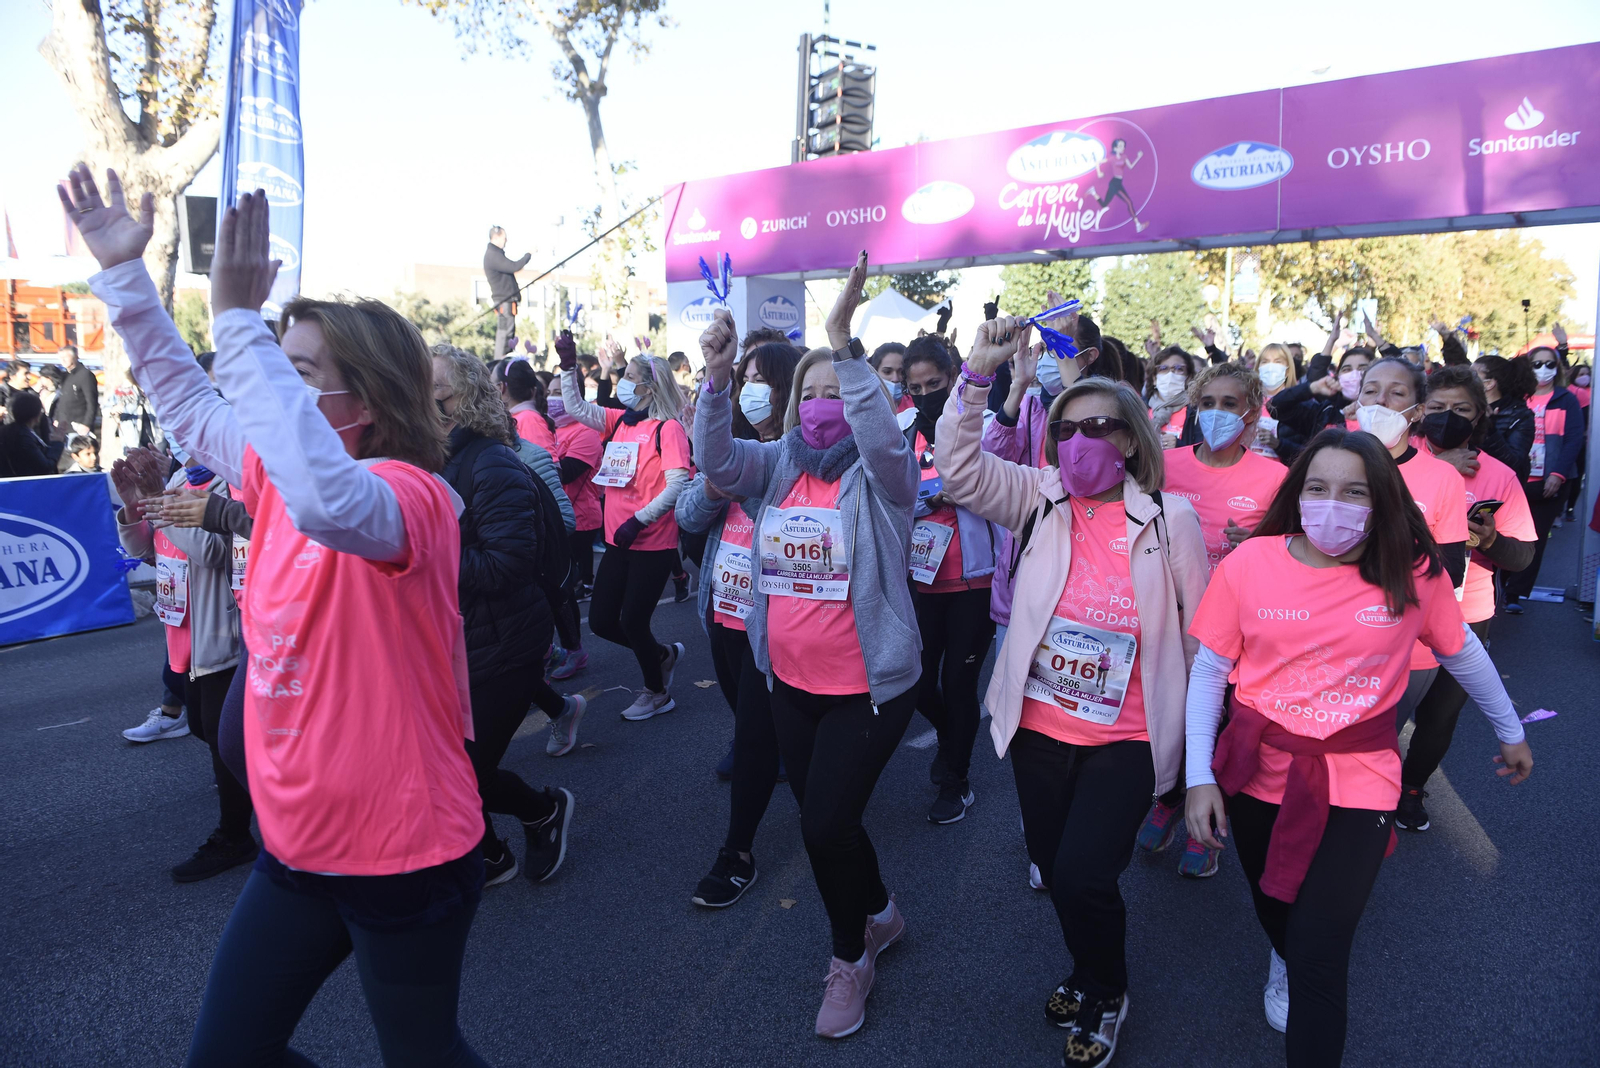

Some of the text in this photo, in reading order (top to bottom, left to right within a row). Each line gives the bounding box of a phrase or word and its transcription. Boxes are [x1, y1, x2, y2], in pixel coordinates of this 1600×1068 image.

[1468, 130, 1581, 157] Santander
[1326, 138, 1431, 169] OYSHO
[1200, 160, 1285, 180] ASTURIANA
[998, 182, 1080, 210] Carrera
[826, 204, 887, 227] OYSHO
[1017, 198, 1110, 243] de la Mujer
[761, 216, 807, 233] ZURICH
[673, 230, 721, 246] Santander
[762, 307, 797, 321] ASTURIANA
[611, 459, 626, 468] 016
[1229, 499, 1256, 509] ASTURIANA
[784, 523, 821, 534] ASTURIANA
[233, 546, 250, 560] 01
[784, 543, 821, 560] 016
[777, 570, 797, 578] CARRERA
[792, 562, 812, 572] 3505
[722, 571, 750, 589] 016
[761, 580, 790, 590] OYSHO
[723, 586, 740, 596] 3170
[739, 597, 754, 607] MUJER
[1085, 607, 1139, 628] TODAS
[1257, 608, 1310, 621] OYSHO
[1056, 634, 1100, 653] ASTURIANA
[1051, 654, 1096, 680] 016
[1036, 675, 1061, 691] CARRERA
[1061, 687, 1070, 695] DE
[1071, 689, 1080, 697] LA
[1081, 692, 1104, 703] MUJER
[1057, 675, 1080, 689] 3506
[1345, 676, 1382, 690] POR
[1320, 690, 1379, 709] TODAS
[1091, 709, 1112, 718] ZURICH
